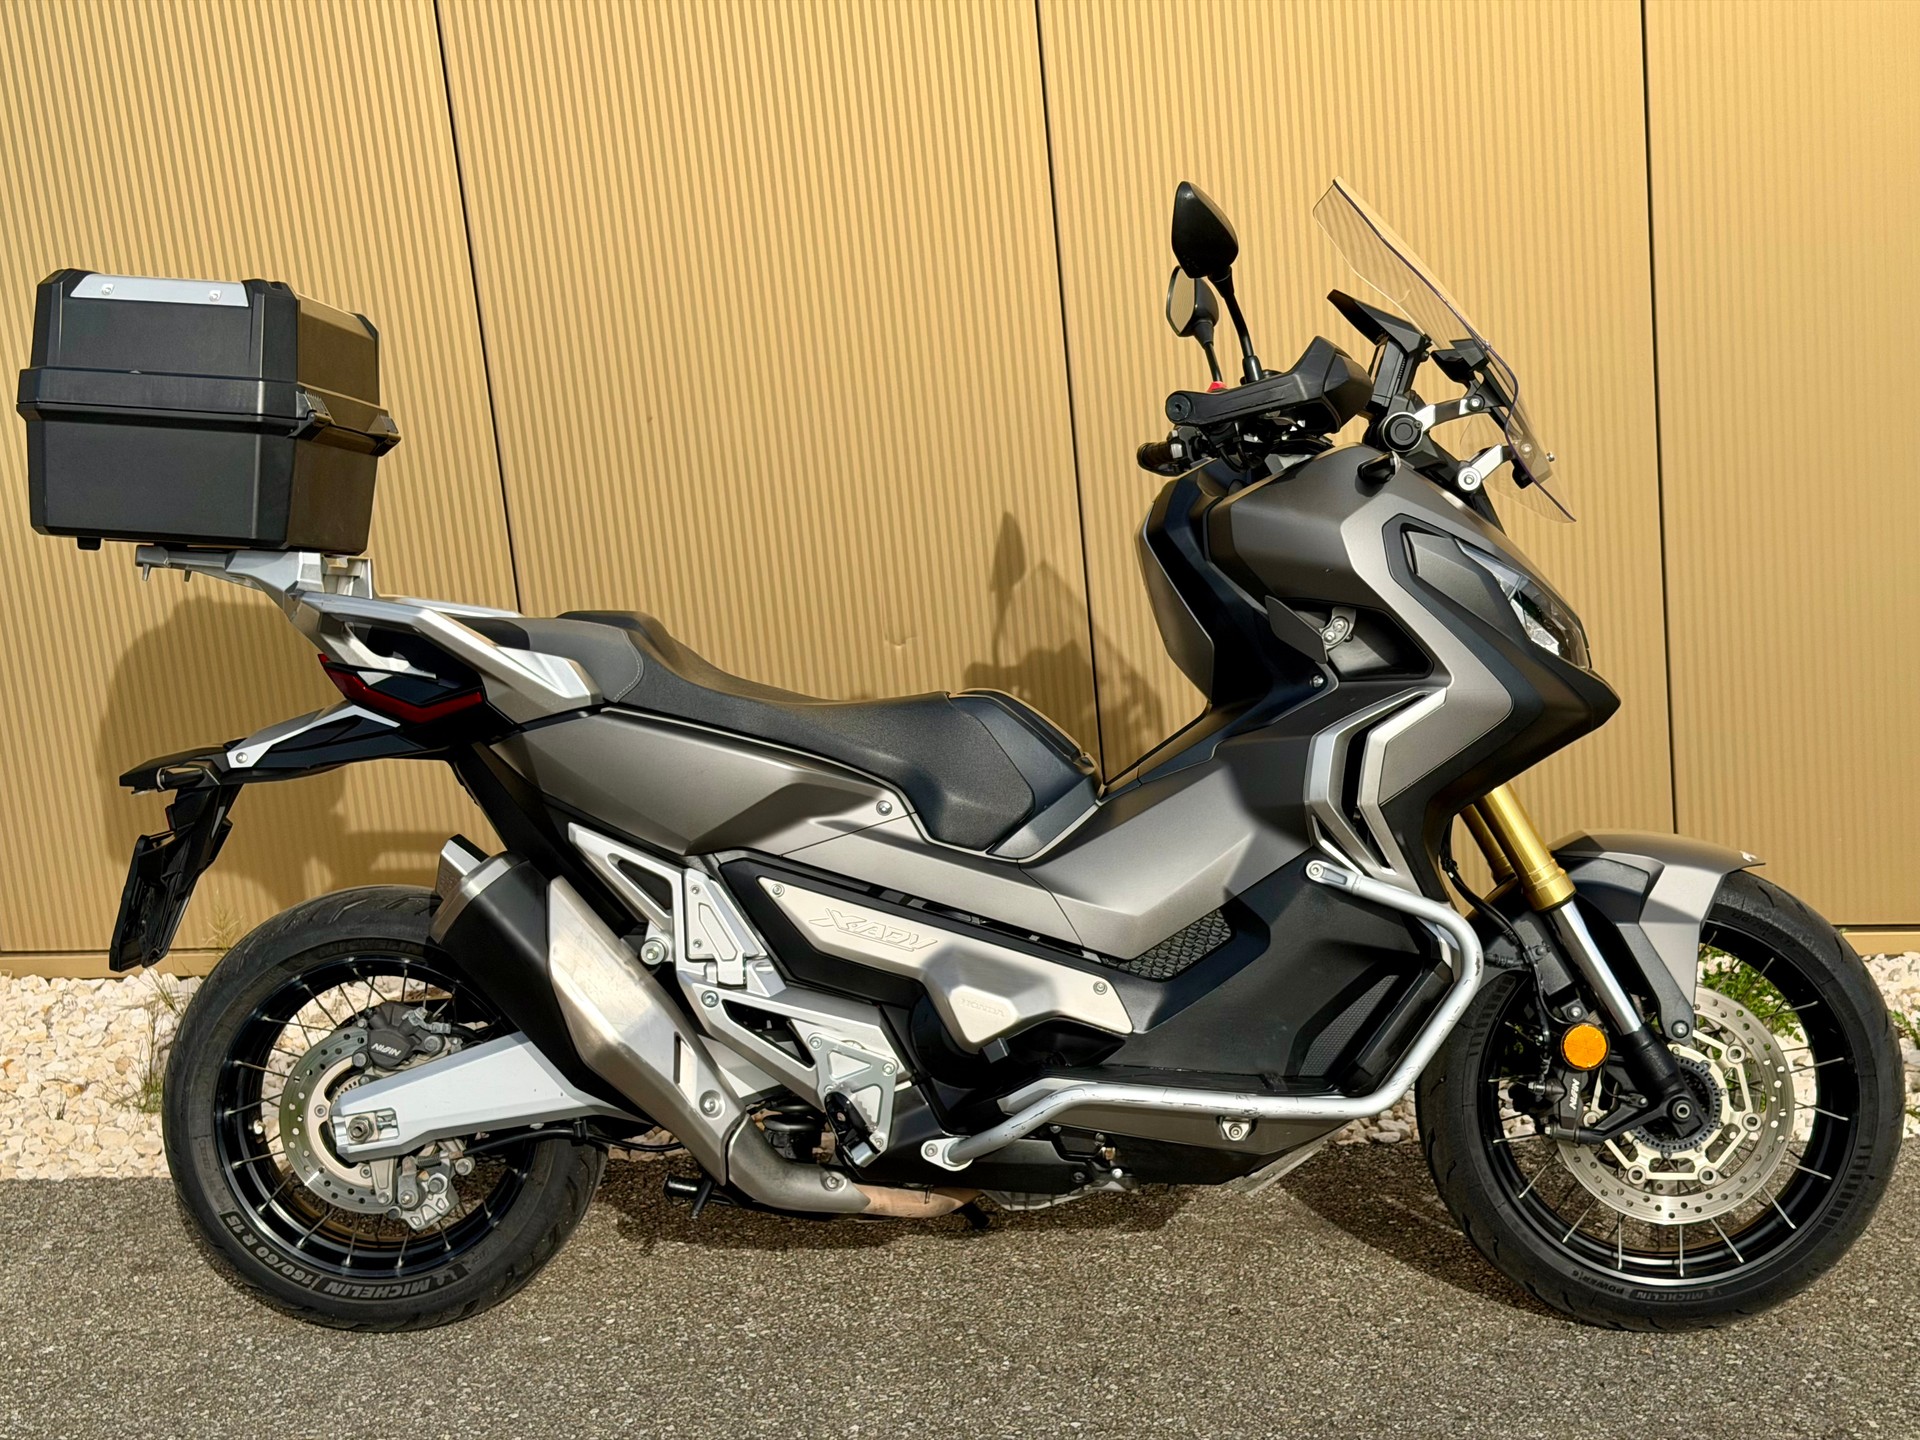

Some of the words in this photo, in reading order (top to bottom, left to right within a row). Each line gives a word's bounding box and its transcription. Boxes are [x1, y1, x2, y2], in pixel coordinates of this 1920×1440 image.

[959, 997, 1006, 1018] HONDA
[225, 1215, 246, 1234] 15
[242, 1232, 258, 1247] R
[255, 1246, 314, 1285] 160/60
[323, 1278, 431, 1299] MICHELIN
[1635, 1290, 1704, 1301] MICHELIN
